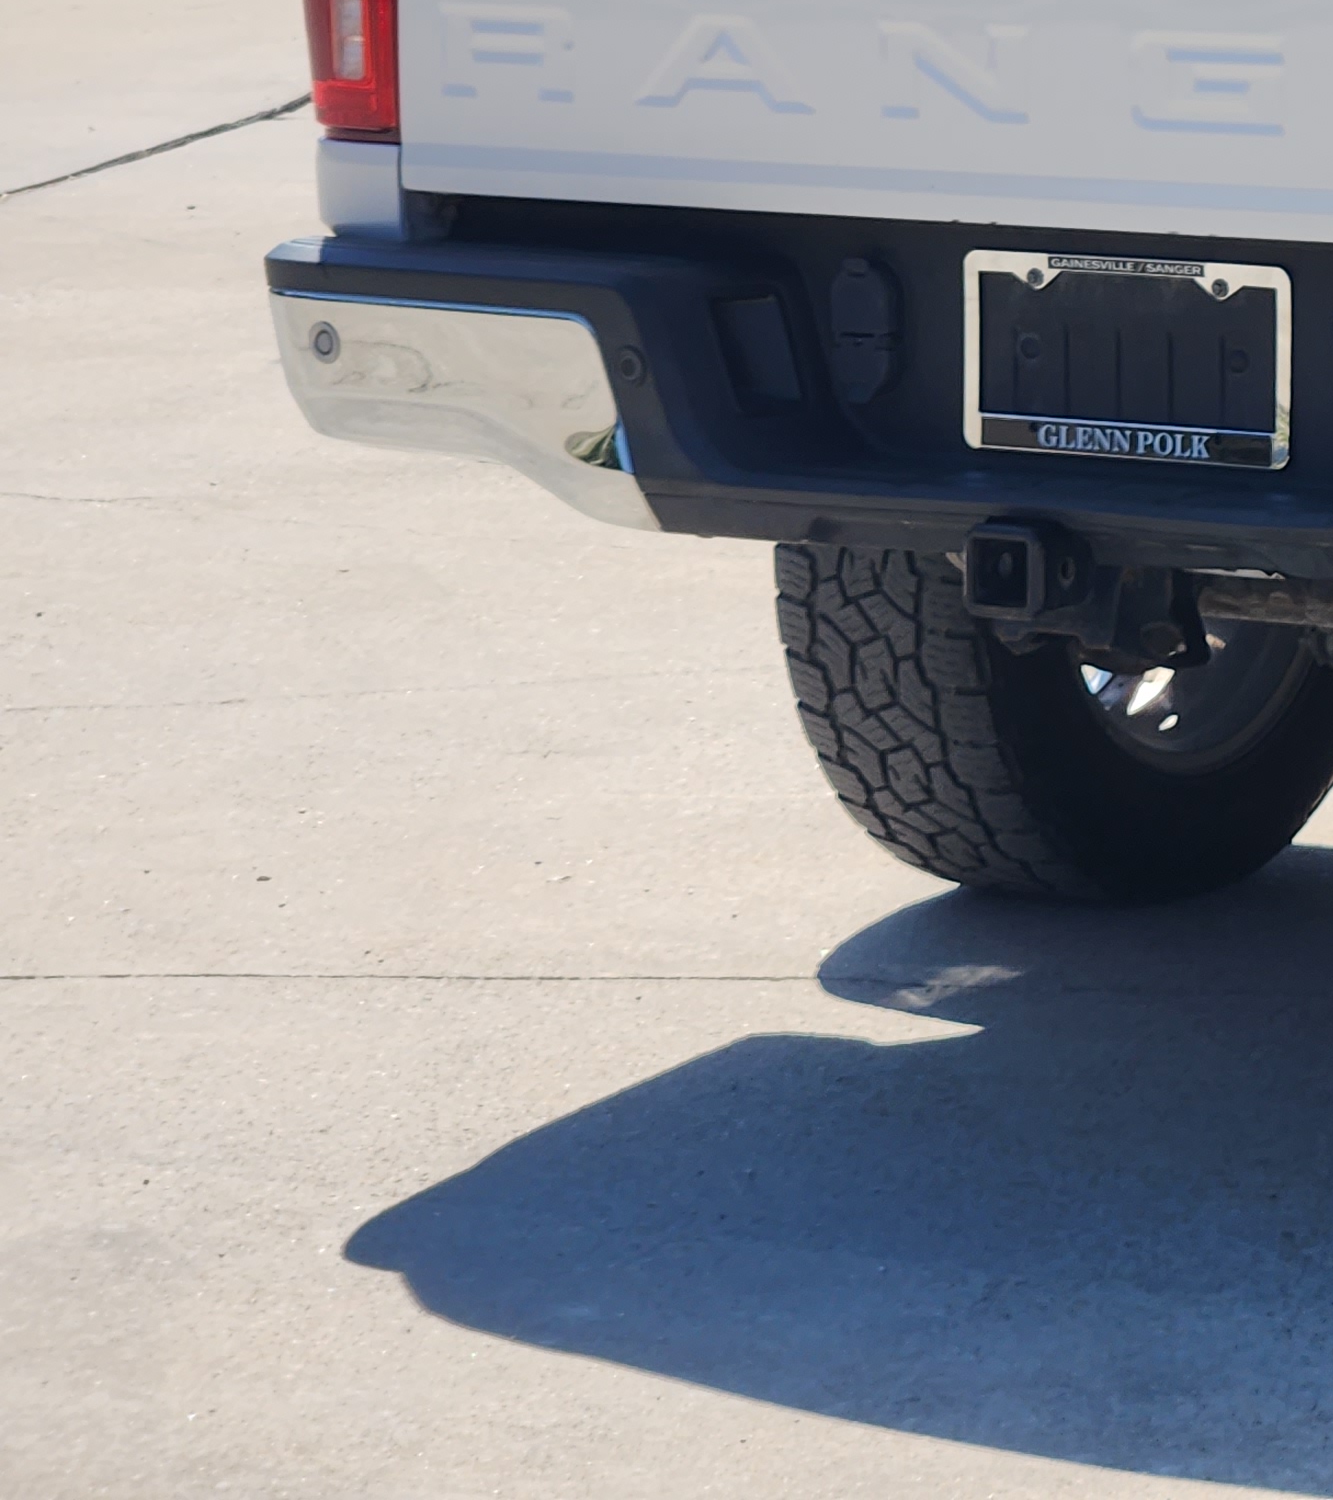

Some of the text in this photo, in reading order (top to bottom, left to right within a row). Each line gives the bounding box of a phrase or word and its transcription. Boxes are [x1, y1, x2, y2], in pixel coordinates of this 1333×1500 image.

[1050, 257, 1135, 272] GAINESVILLE
[1145, 263, 1202, 276] SANGER
[1037, 423, 1211, 459] GLENN POLK
